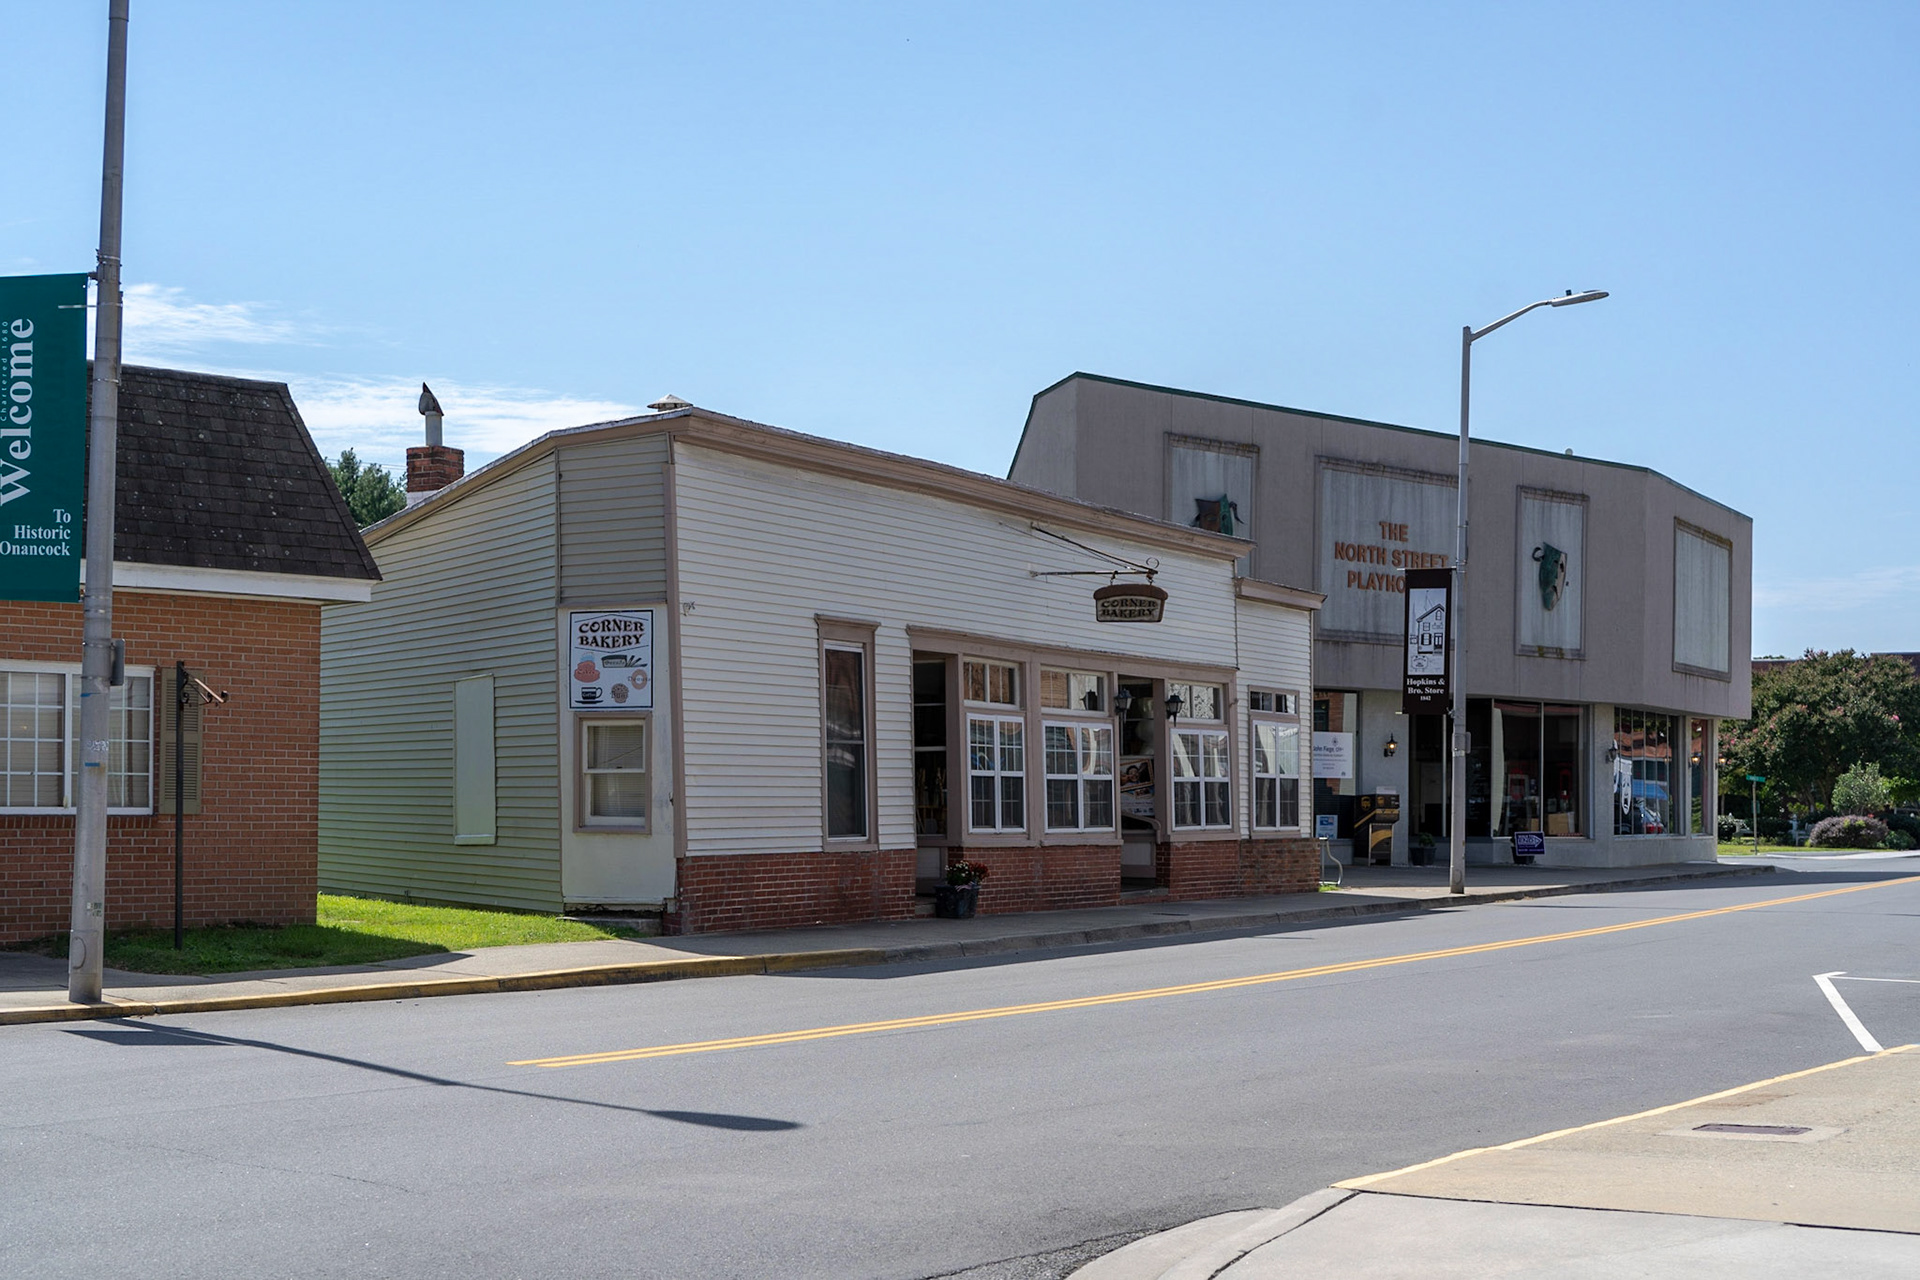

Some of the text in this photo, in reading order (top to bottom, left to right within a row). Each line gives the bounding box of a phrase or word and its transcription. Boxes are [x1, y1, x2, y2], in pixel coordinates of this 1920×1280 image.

[0, 318, 34, 506] Welcome
[53, 508, 71, 524] To
[14, 524, 71, 540] Historic
[1378, 521, 1409, 543] THE
[0, 540, 71, 556] Onancock
[1334, 542, 1449, 569] NORTH STREET
[1101, 598, 1157, 607] CORNER
[1100, 607, 1158, 617] BAKERY
[578, 619, 644, 633] CORNER
[578, 633, 645, 648] BAKERY
[1406, 678, 1446, 687] Hopkins &
[1407, 686, 1445, 694] Bro. Store
